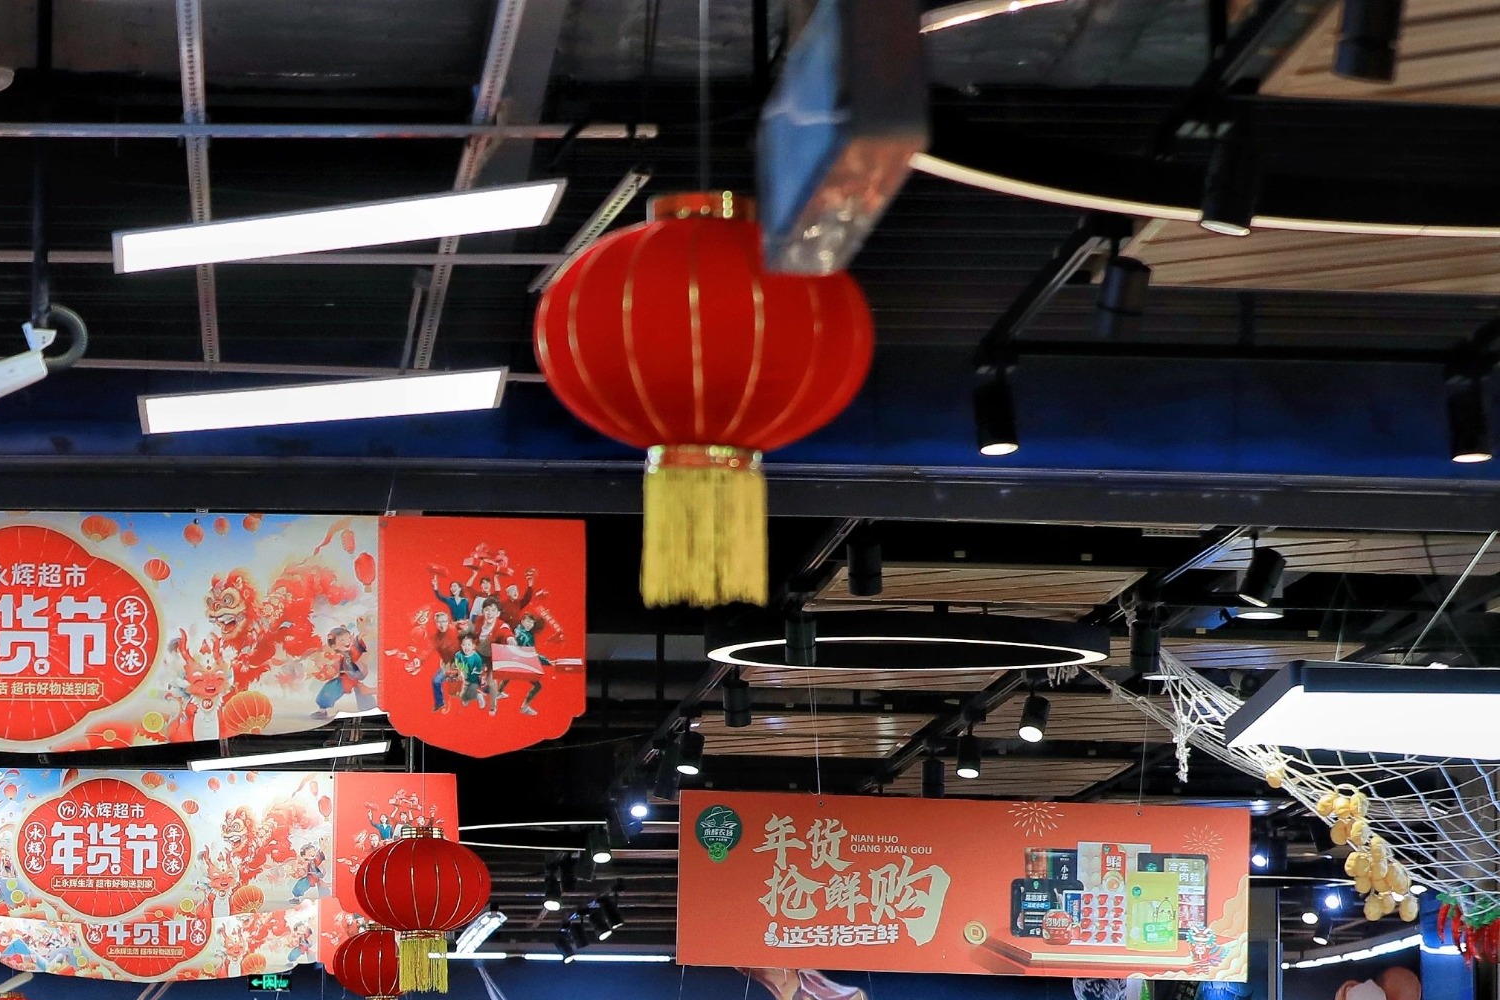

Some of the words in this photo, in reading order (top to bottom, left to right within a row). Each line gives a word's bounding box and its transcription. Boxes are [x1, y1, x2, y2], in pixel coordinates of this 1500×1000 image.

[120, 600, 143, 671] 年更浓
[10, 682, 100, 697] 超市好物送到家
[79, 803, 146, 819] 永辉超市
[28, 824, 43, 871] 永辉龙
[51, 822, 158, 875] 年货节
[165, 826, 181, 873] 年更浓
[752, 813, 856, 872] 年货
[850, 834, 874, 843] NIAN
[877, 835, 899, 843] HUO
[850, 844, 881, 854] QIANG
[884, 845, 908, 854] XIAN
[910, 846, 933, 855] GOU
[757, 855, 951, 946] 抢鲜购
